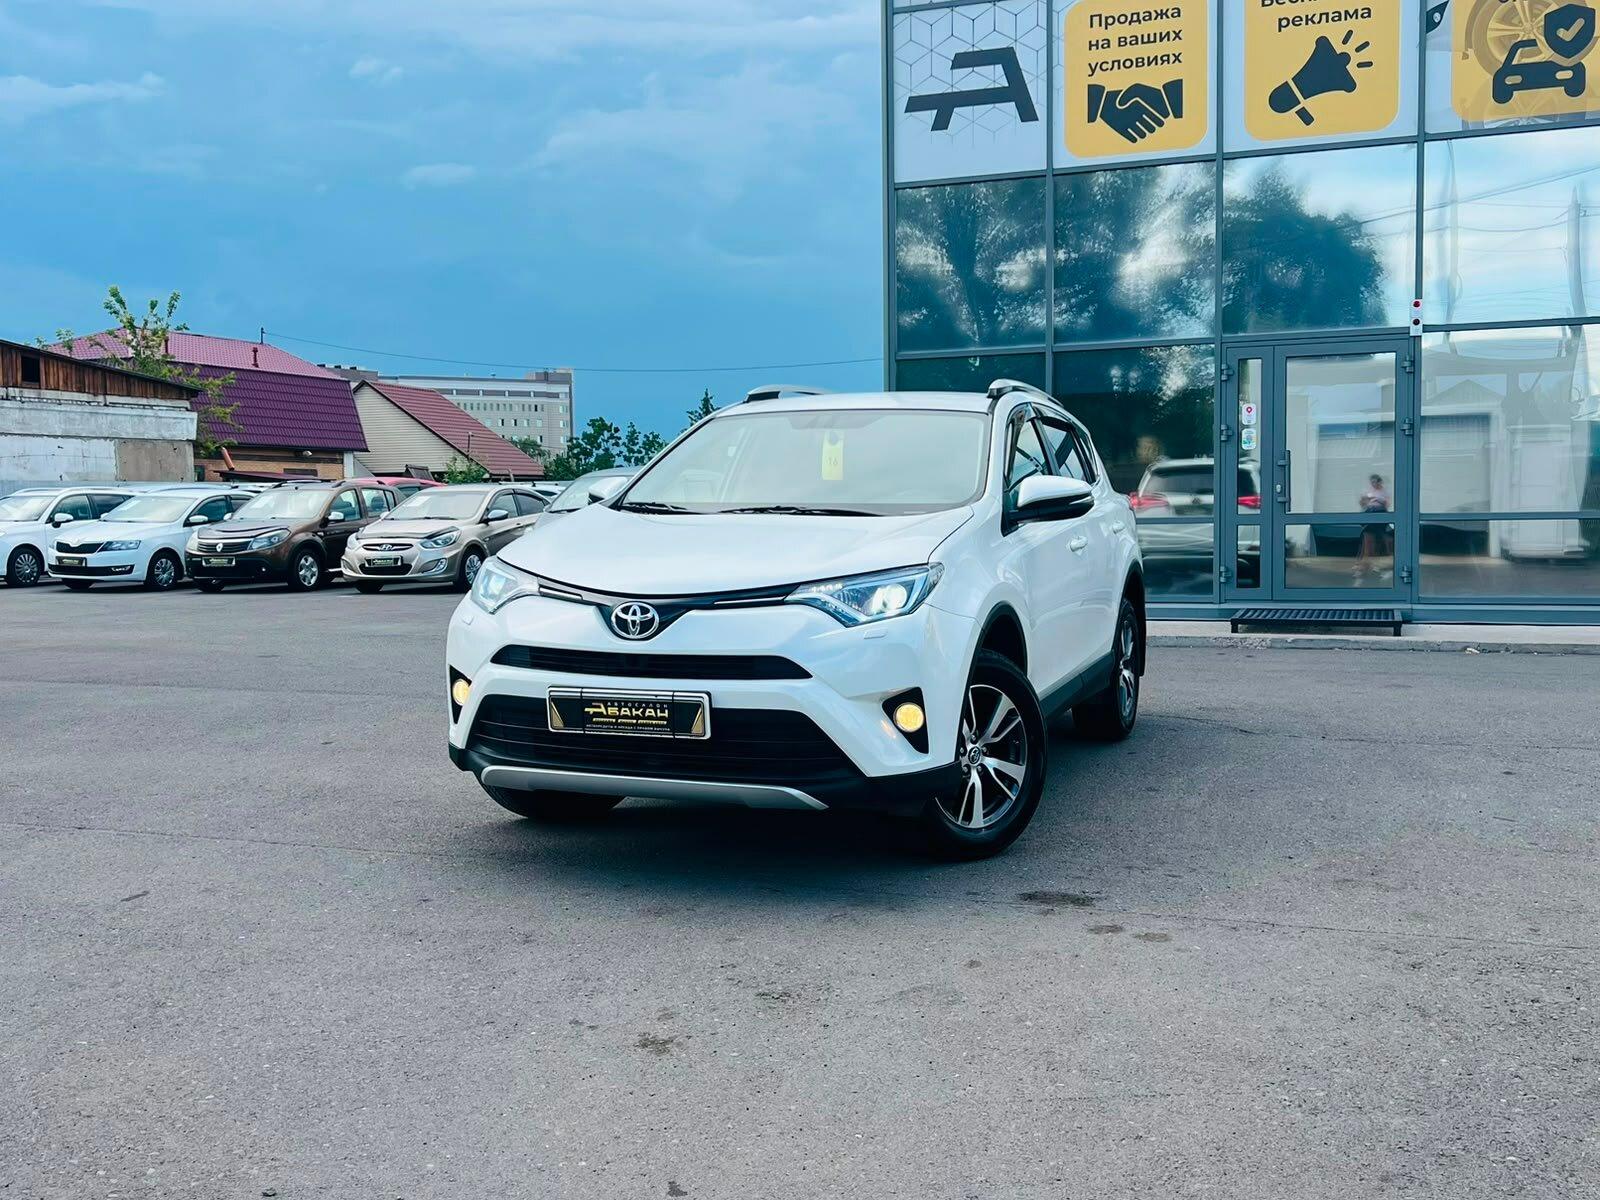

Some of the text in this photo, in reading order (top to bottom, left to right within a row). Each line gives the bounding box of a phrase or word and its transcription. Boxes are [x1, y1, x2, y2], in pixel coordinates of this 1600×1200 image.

[1089, 6, 1181, 30] Продажа
[1277, 7, 1372, 32] реклама
[1088, 29, 1183, 51] на ваших
[1087, 52, 1183, 77] условиях
